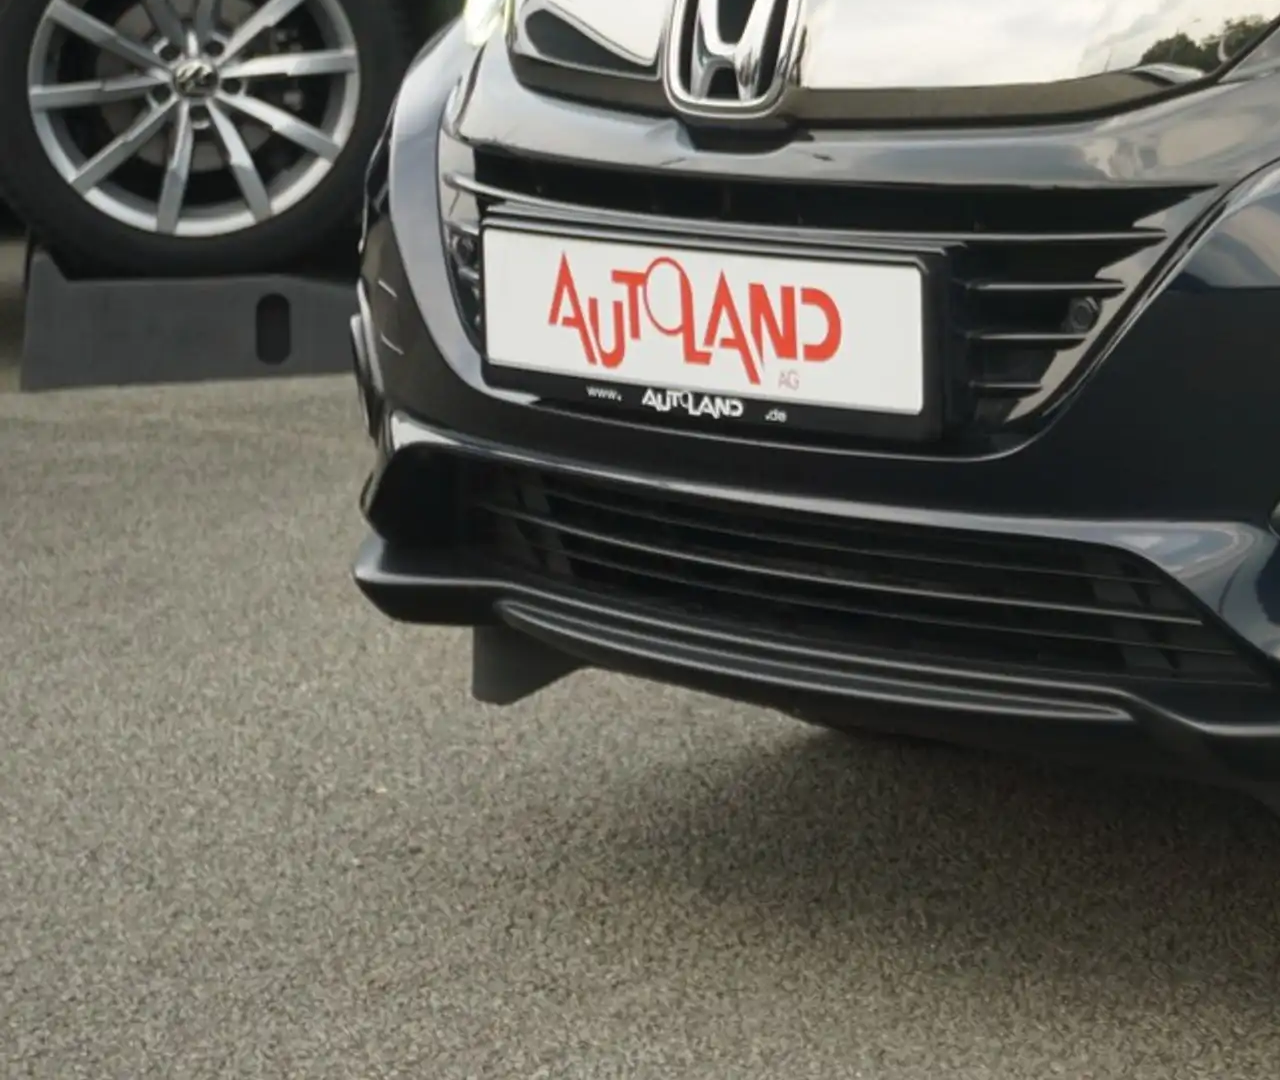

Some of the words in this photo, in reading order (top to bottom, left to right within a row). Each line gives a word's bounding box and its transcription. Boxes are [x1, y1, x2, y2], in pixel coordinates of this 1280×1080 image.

[549, 251, 843, 386] AUTOLAND
[778, 370, 800, 391] AG
[641, 387, 744, 420] AUTOLAND
